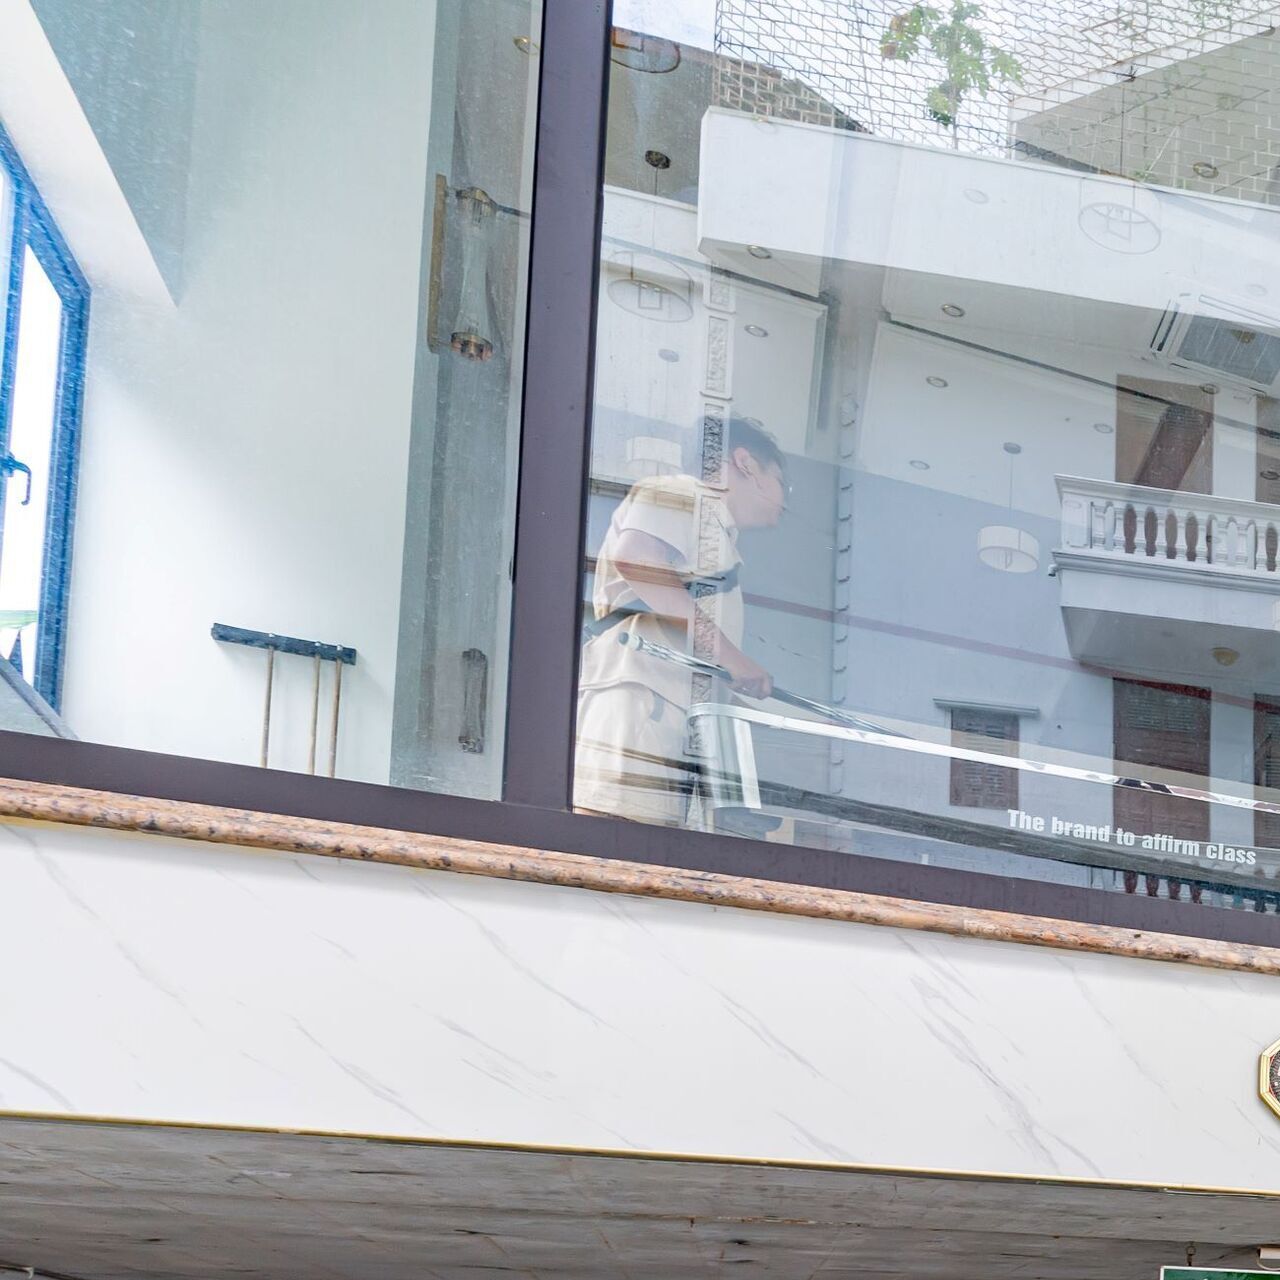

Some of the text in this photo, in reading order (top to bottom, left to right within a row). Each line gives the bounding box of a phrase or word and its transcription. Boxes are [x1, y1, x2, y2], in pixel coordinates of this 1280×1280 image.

[1008, 809, 1257, 865] The brand to affirm class
